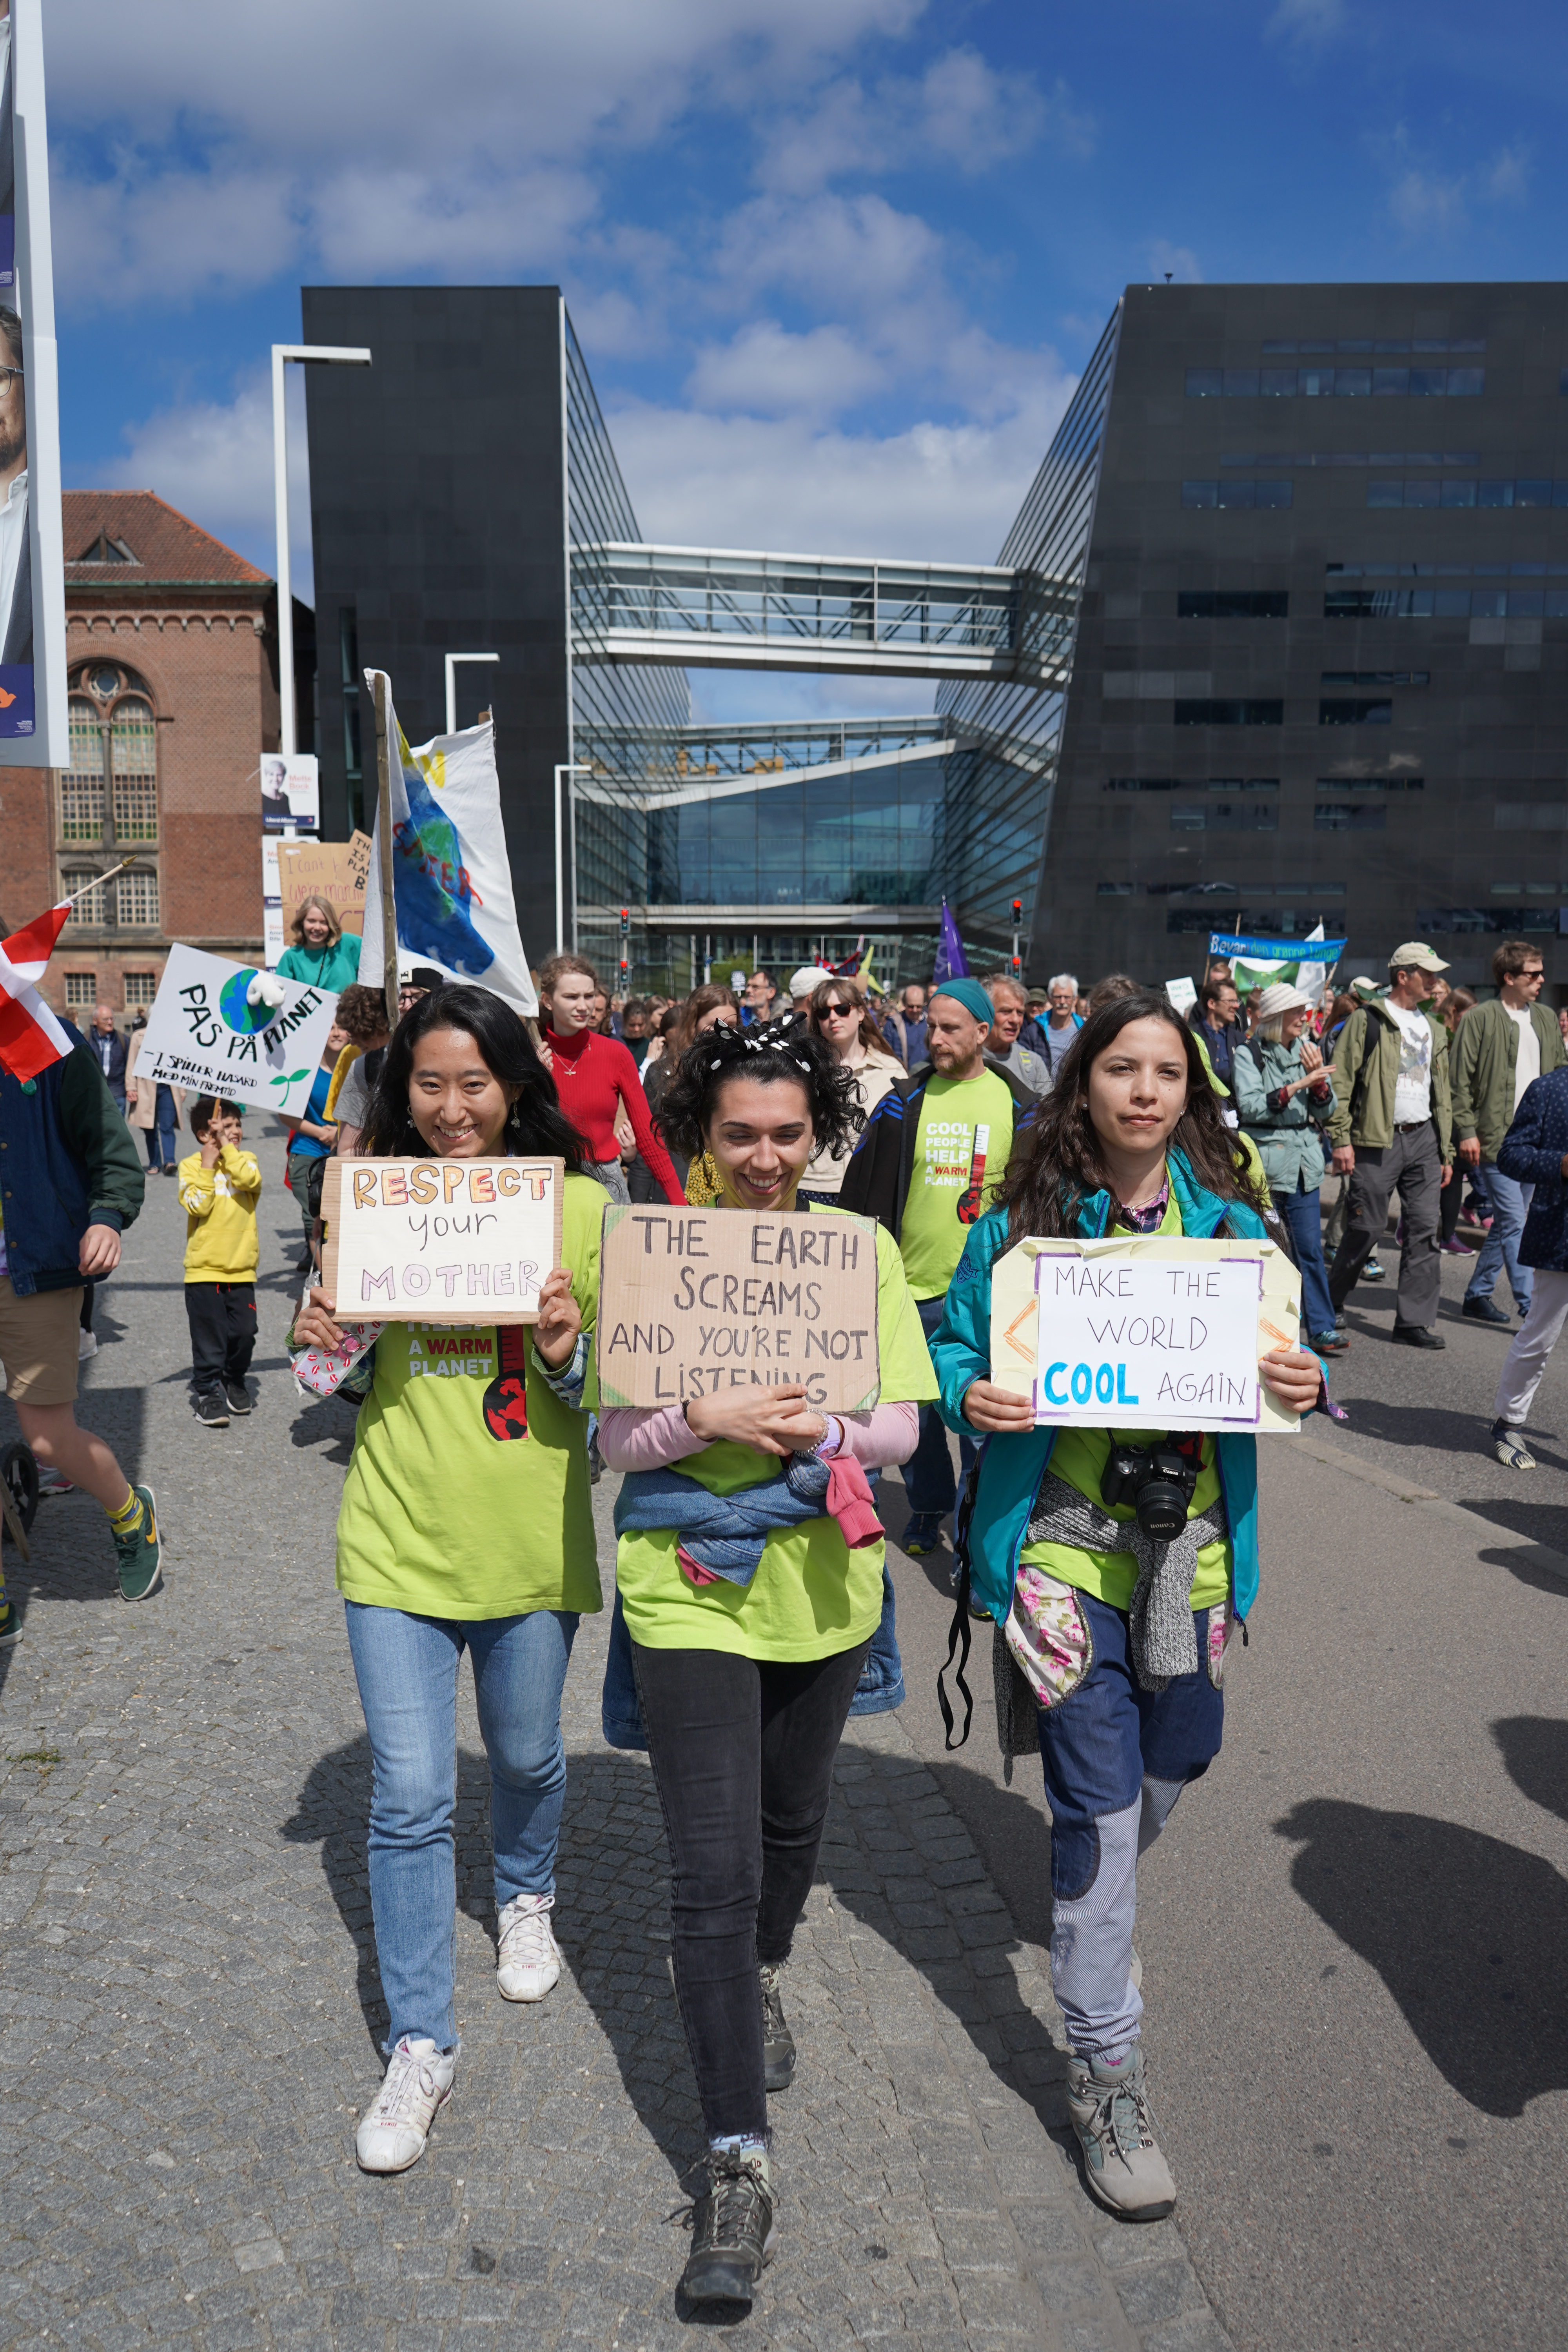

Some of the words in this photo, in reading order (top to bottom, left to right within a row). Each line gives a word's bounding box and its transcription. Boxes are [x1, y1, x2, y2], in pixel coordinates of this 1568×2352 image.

[355, 876, 366, 891] B
[1210, 934, 1246, 954] Bevar
[179, 984, 223, 1047] PAS
[227, 1034, 257, 1063] PÅ
[263, 987, 323, 1054] PLANET
[151, 1068, 179, 1080] MED
[926, 1122, 972, 1136] COOL
[926, 1138, 971, 1148] PEOPLE
[926, 1150, 969, 1163] HELP
[925, 1176, 967, 1187] PLANET
[926, 1165, 933, 1174] A
[935, 1166, 967, 1176] WARM
[353, 1164, 553, 1209] RESPECT
[408, 1214, 497, 1251] your
[632, 1216, 709, 1257] THE
[751, 1225, 858, 1269] EARTH
[361, 1260, 541, 1301] MOTHER
[674, 1266, 822, 1321] SCREAMS
[1056, 1266, 1134, 1297] MAKE
[1167, 1271, 1221, 1298] THE
[408, 1339, 423, 1355] A
[426, 1338, 492, 1355] WARM
[608, 1323, 675, 1355] AND
[699, 1325, 790, 1358] YOU'RE
[805, 1329, 868, 1361] NOT
[1087, 1316, 1208, 1351] WORLD
[409, 1359, 492, 1377] PLANET
[1044, 1361, 1139, 1406] COOL
